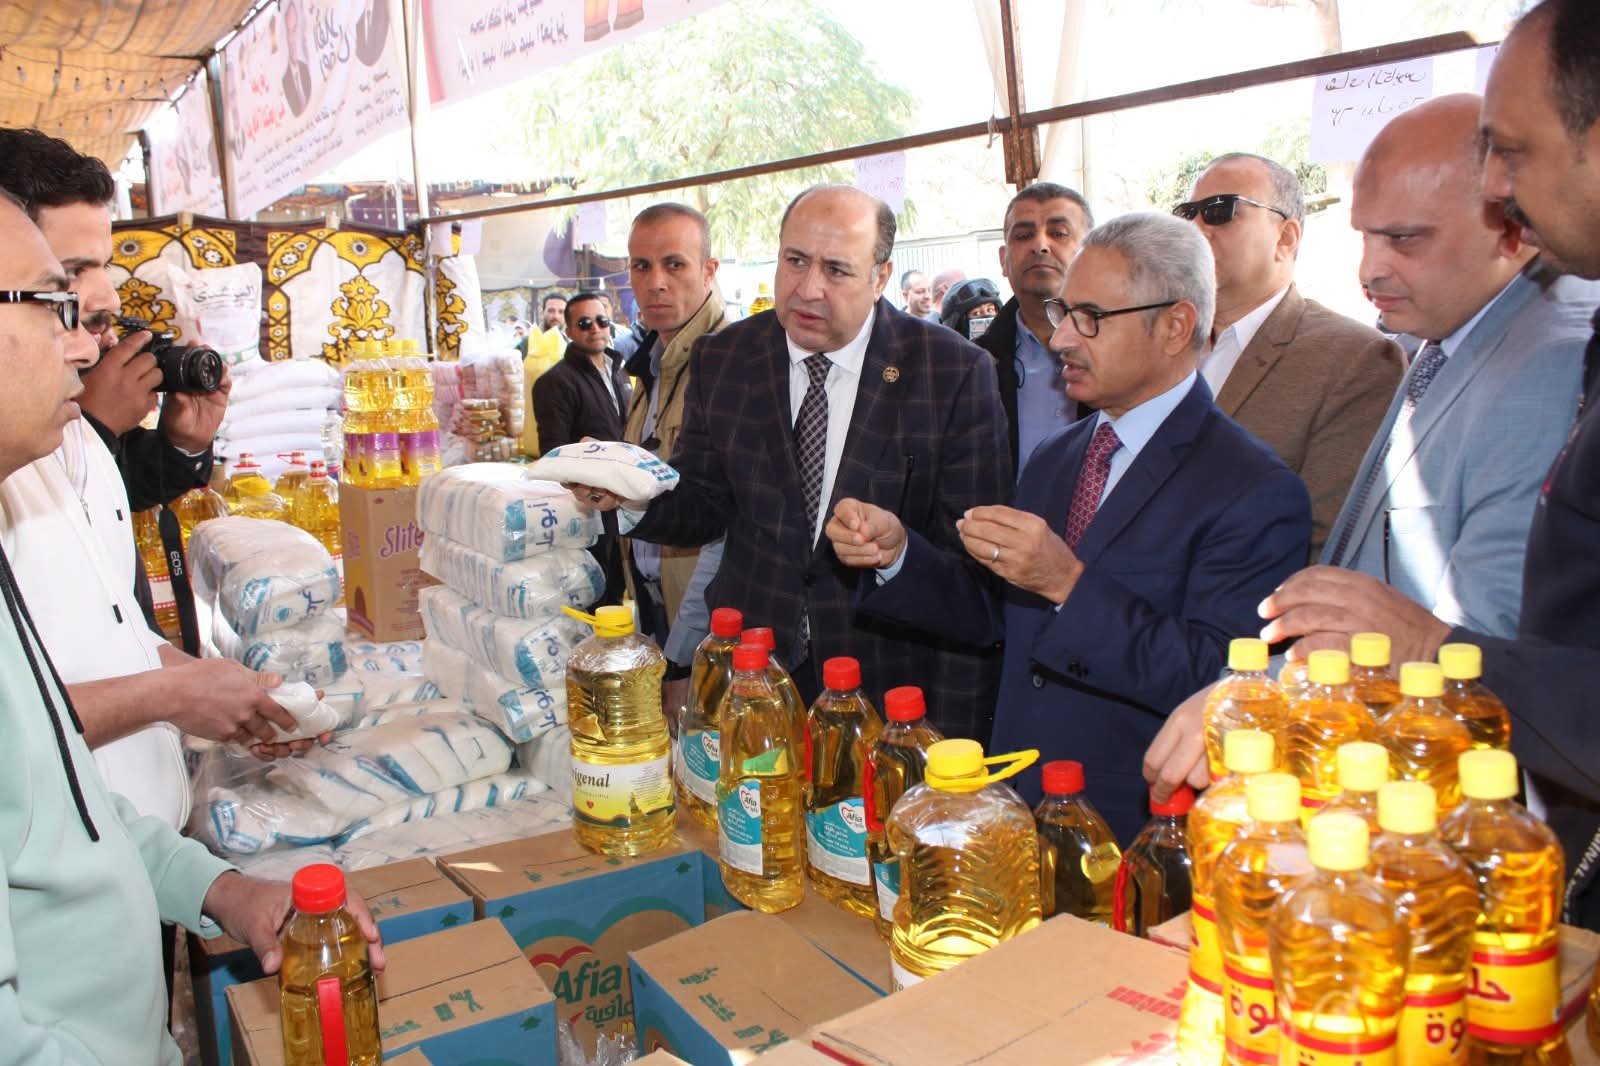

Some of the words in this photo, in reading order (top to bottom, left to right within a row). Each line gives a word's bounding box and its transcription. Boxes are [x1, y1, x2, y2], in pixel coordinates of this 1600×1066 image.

[170, 550, 184, 577] EOS
[553, 959, 623, 1005] Afia
[1466, 966, 1511, 1003] حل
